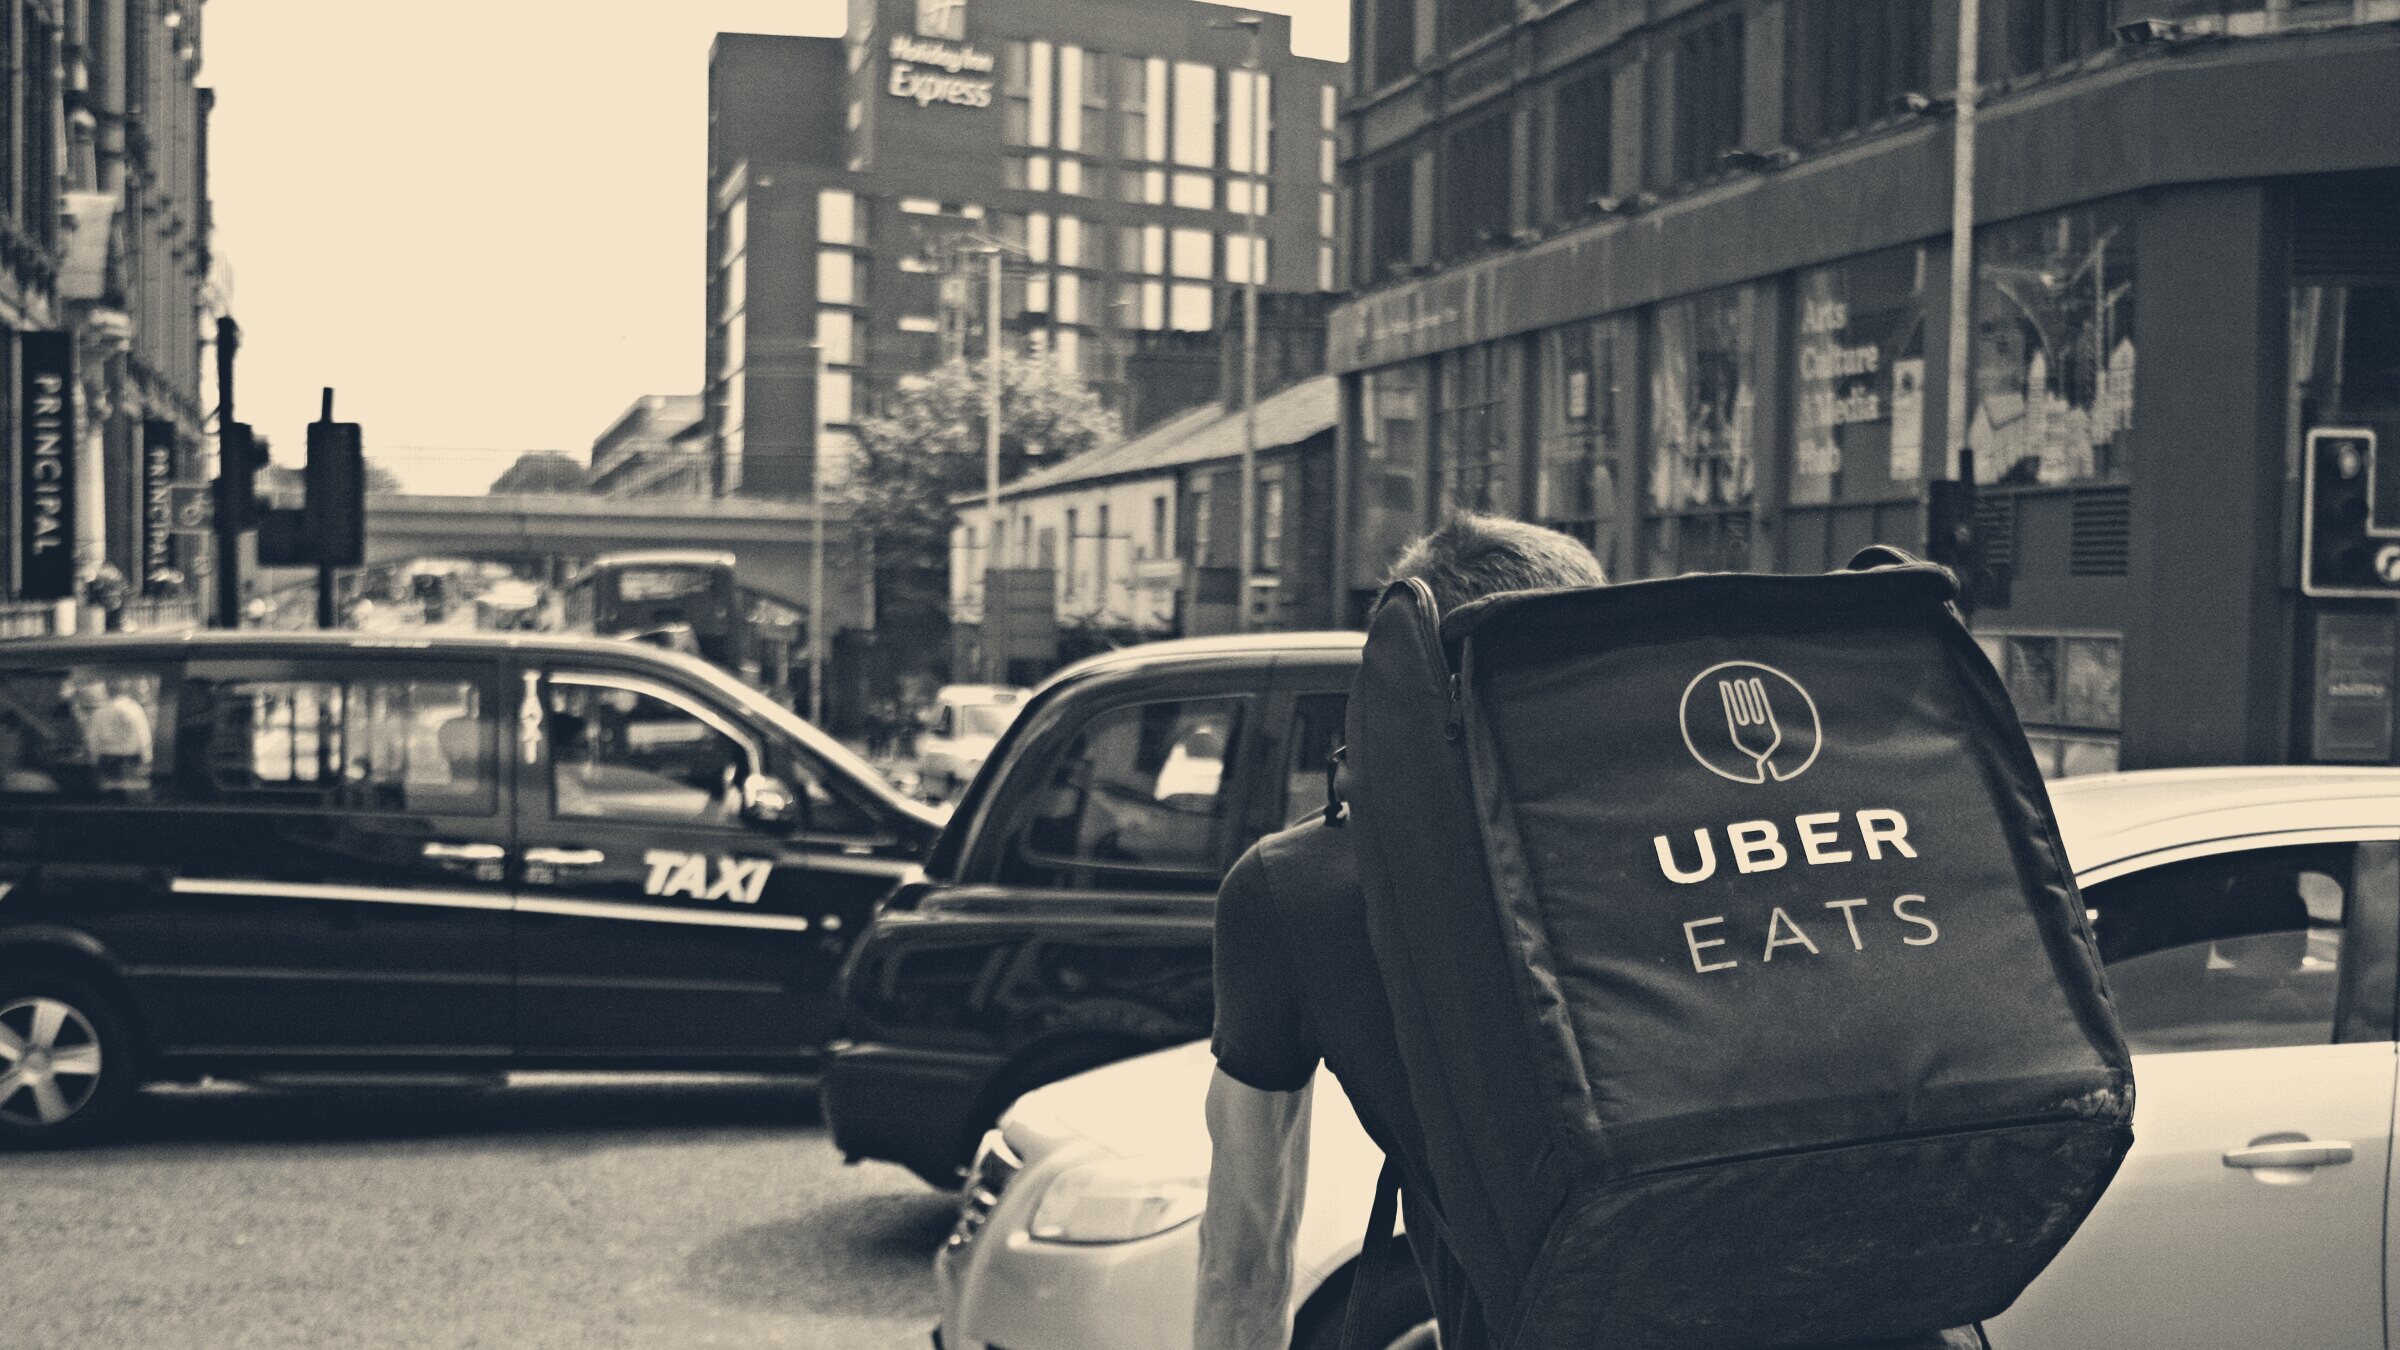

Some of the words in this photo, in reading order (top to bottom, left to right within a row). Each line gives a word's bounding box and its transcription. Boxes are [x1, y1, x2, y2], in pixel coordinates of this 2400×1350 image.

[888, 62, 995, 108] Express
[1802, 299, 1848, 333] Arts
[1800, 343, 1880, 380] Culture
[32, 374, 64, 556] PRINCIPAL
[1653, 808, 1918, 884] UBER
[644, 850, 774, 904] TAXI
[1682, 894, 1940, 974] EATS
